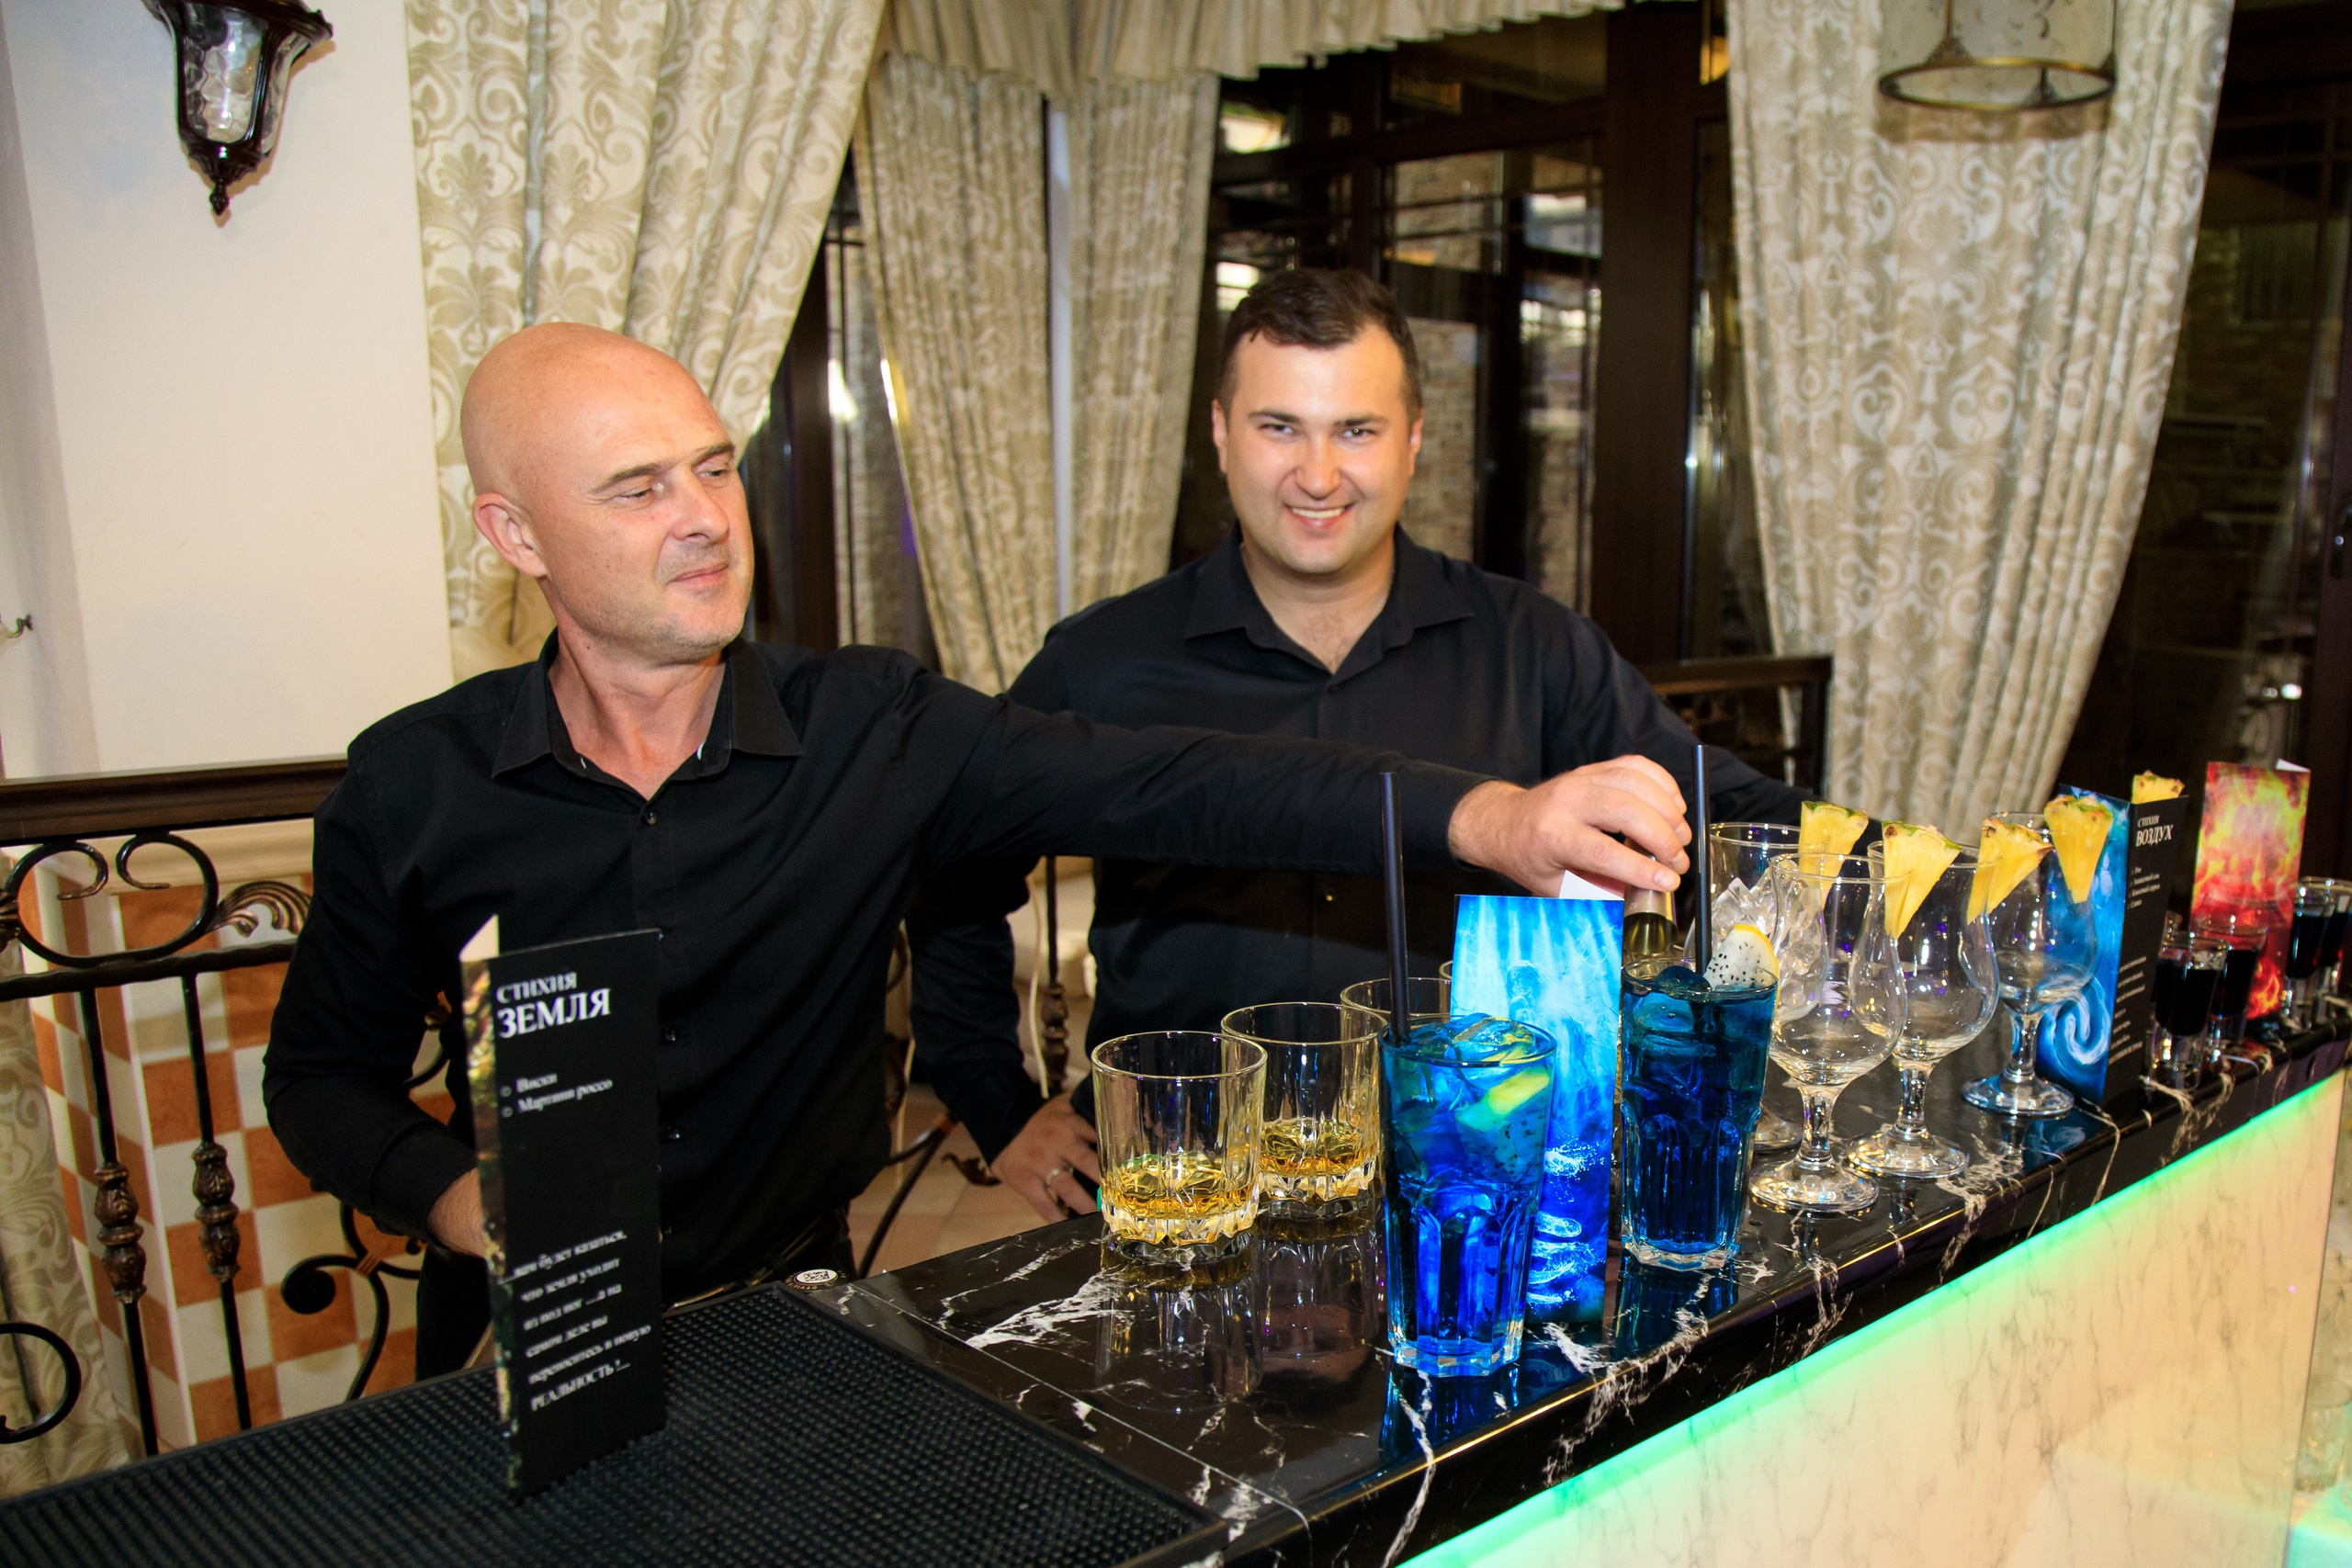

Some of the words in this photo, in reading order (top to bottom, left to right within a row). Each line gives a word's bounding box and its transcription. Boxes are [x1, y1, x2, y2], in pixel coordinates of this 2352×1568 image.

[2136, 824, 2174, 847] ВОЗДУХ
[497, 972, 577, 1004] СТИХИЯ
[497, 987, 611, 1039] ЗЕМЛЯ
[516, 1073, 558, 1093] Виски
[517, 1088, 575, 1113] Мартини
[520, 1287, 544, 1303] что
[579, 1258, 621, 1284] уходит
[530, 1363, 614, 1411] РЕАЛЬНОСТЬ
